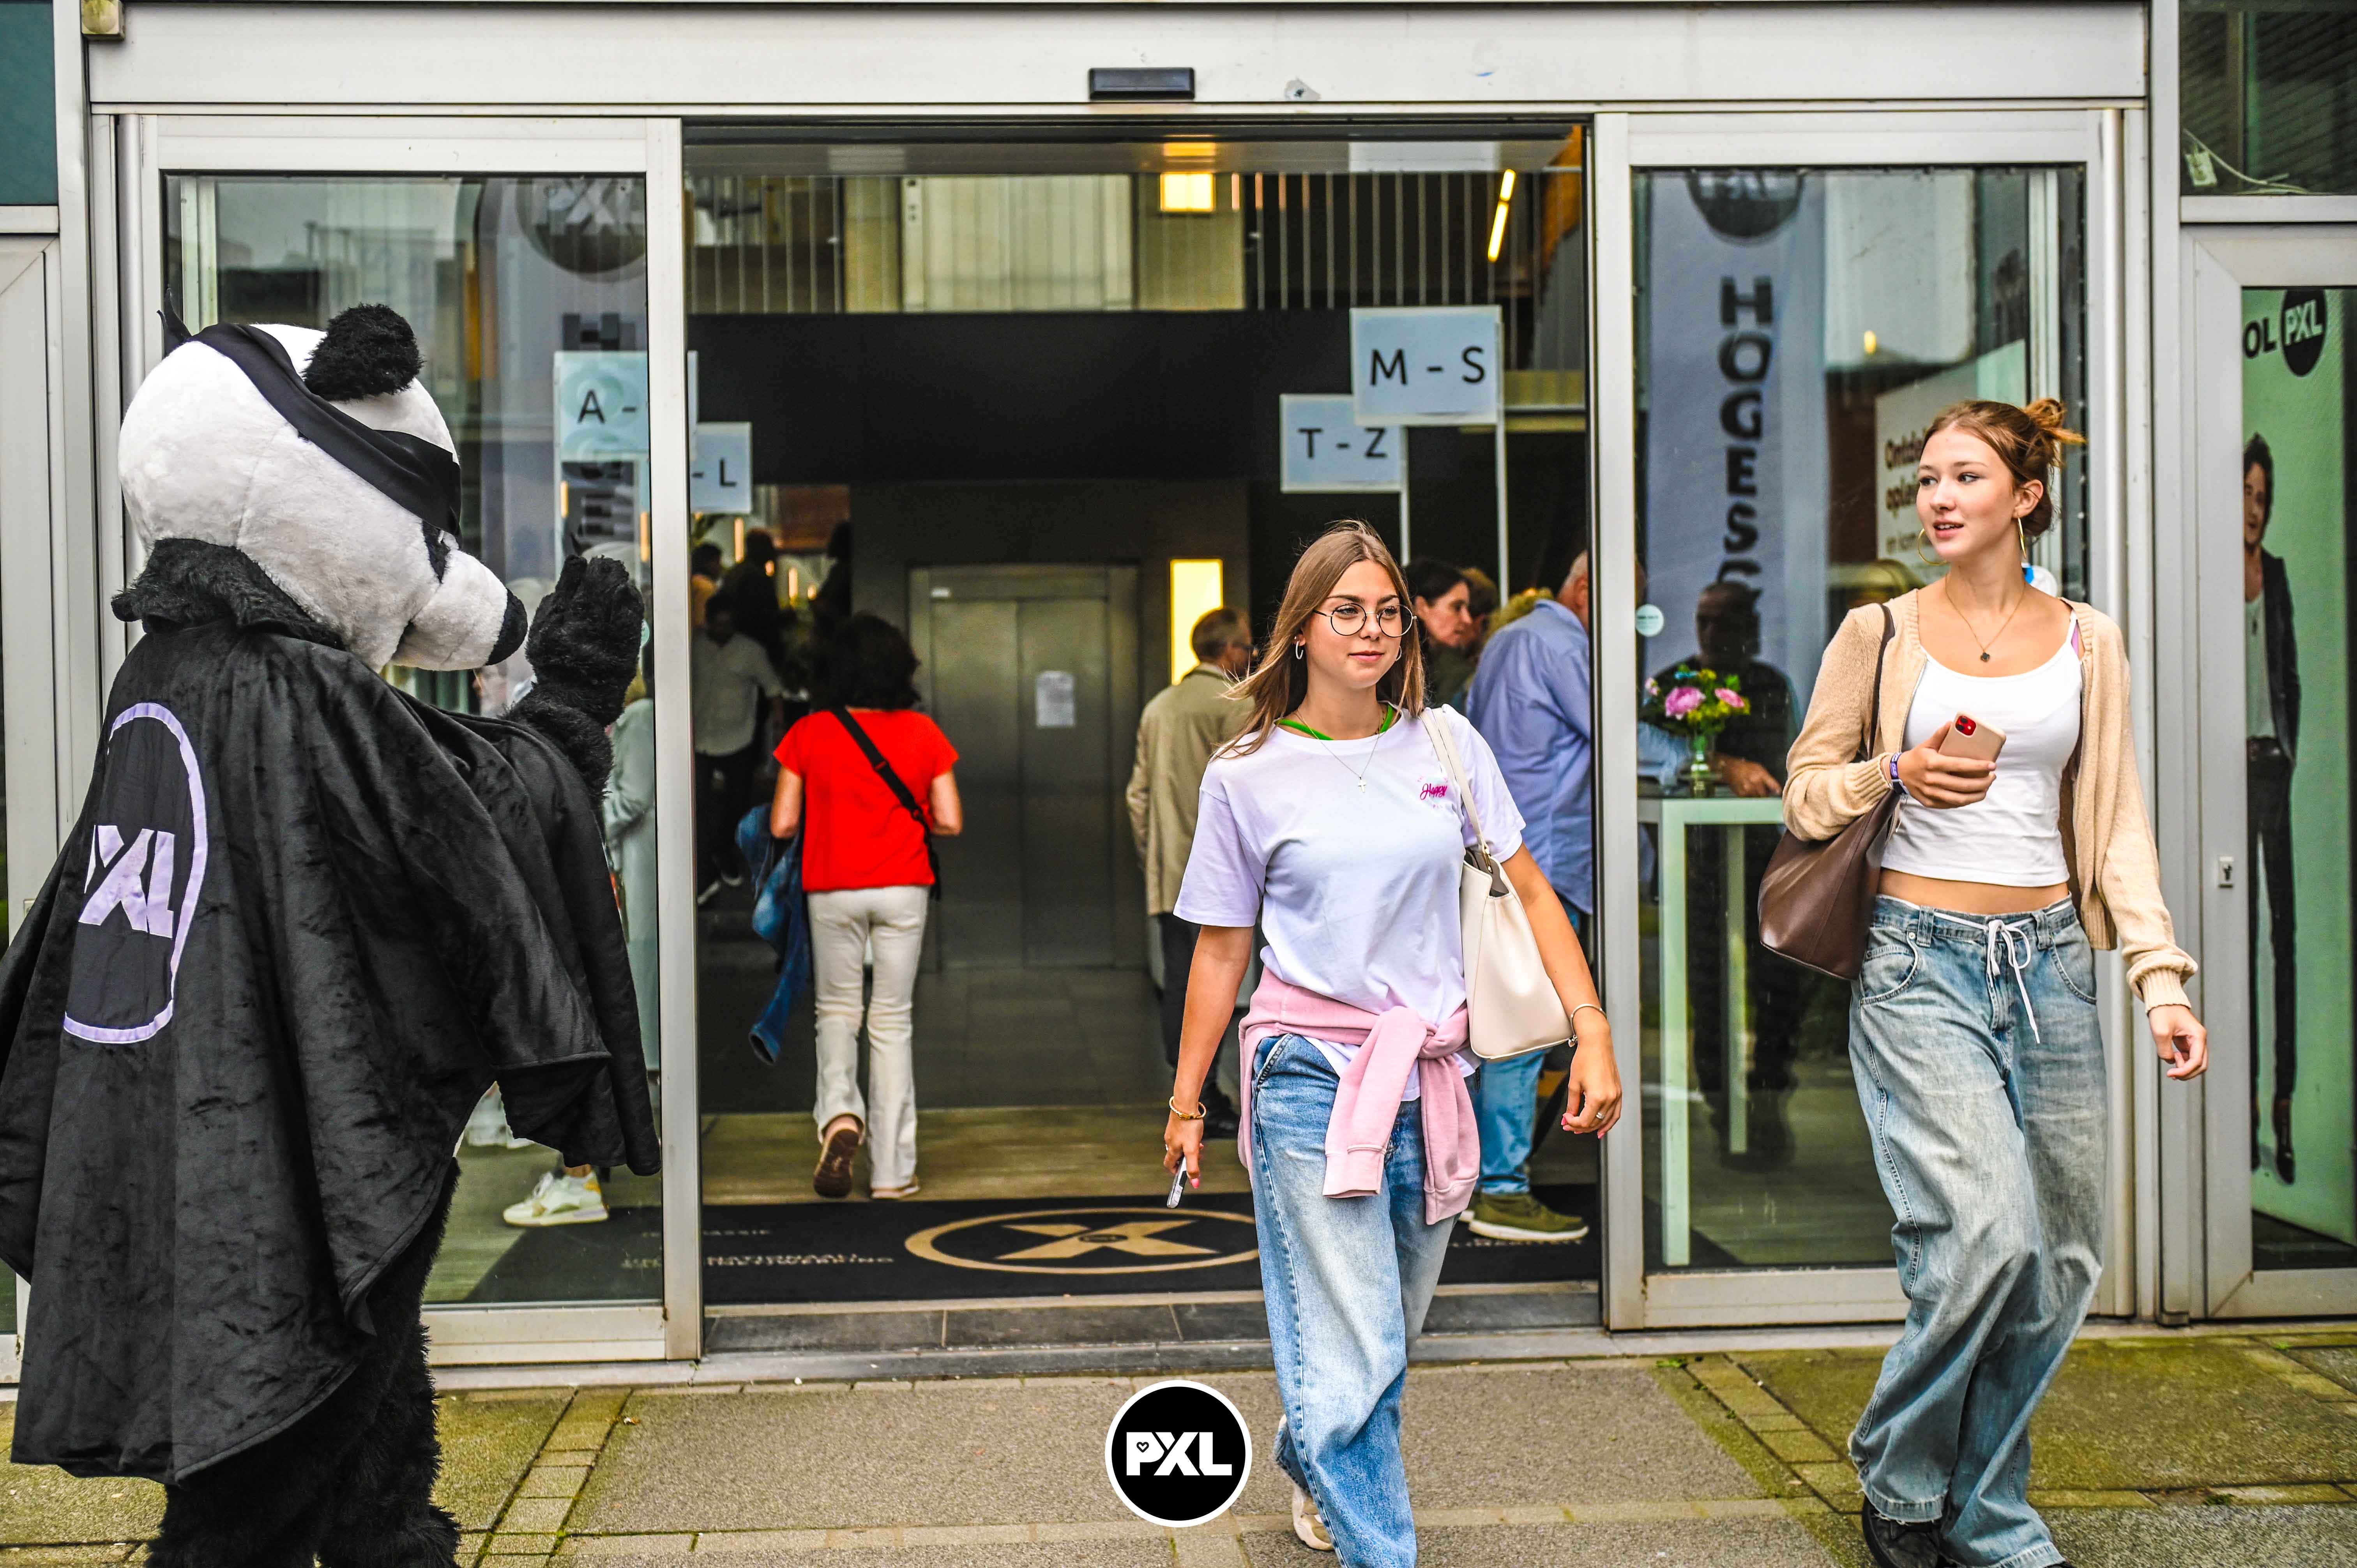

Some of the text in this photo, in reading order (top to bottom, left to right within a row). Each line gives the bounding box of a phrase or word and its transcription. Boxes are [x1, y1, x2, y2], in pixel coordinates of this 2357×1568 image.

[2284, 299, 2323, 346] PXL
[1370, 349, 1408, 386] M
[1461, 346, 1485, 383] S
[578, 390, 606, 424] A
[1298, 428, 1322, 459] T
[1365, 428, 1388, 458] Z
[719, 459, 736, 487] L
[1420, 783, 1448, 800] Happy
[79, 825, 175, 938] XL
